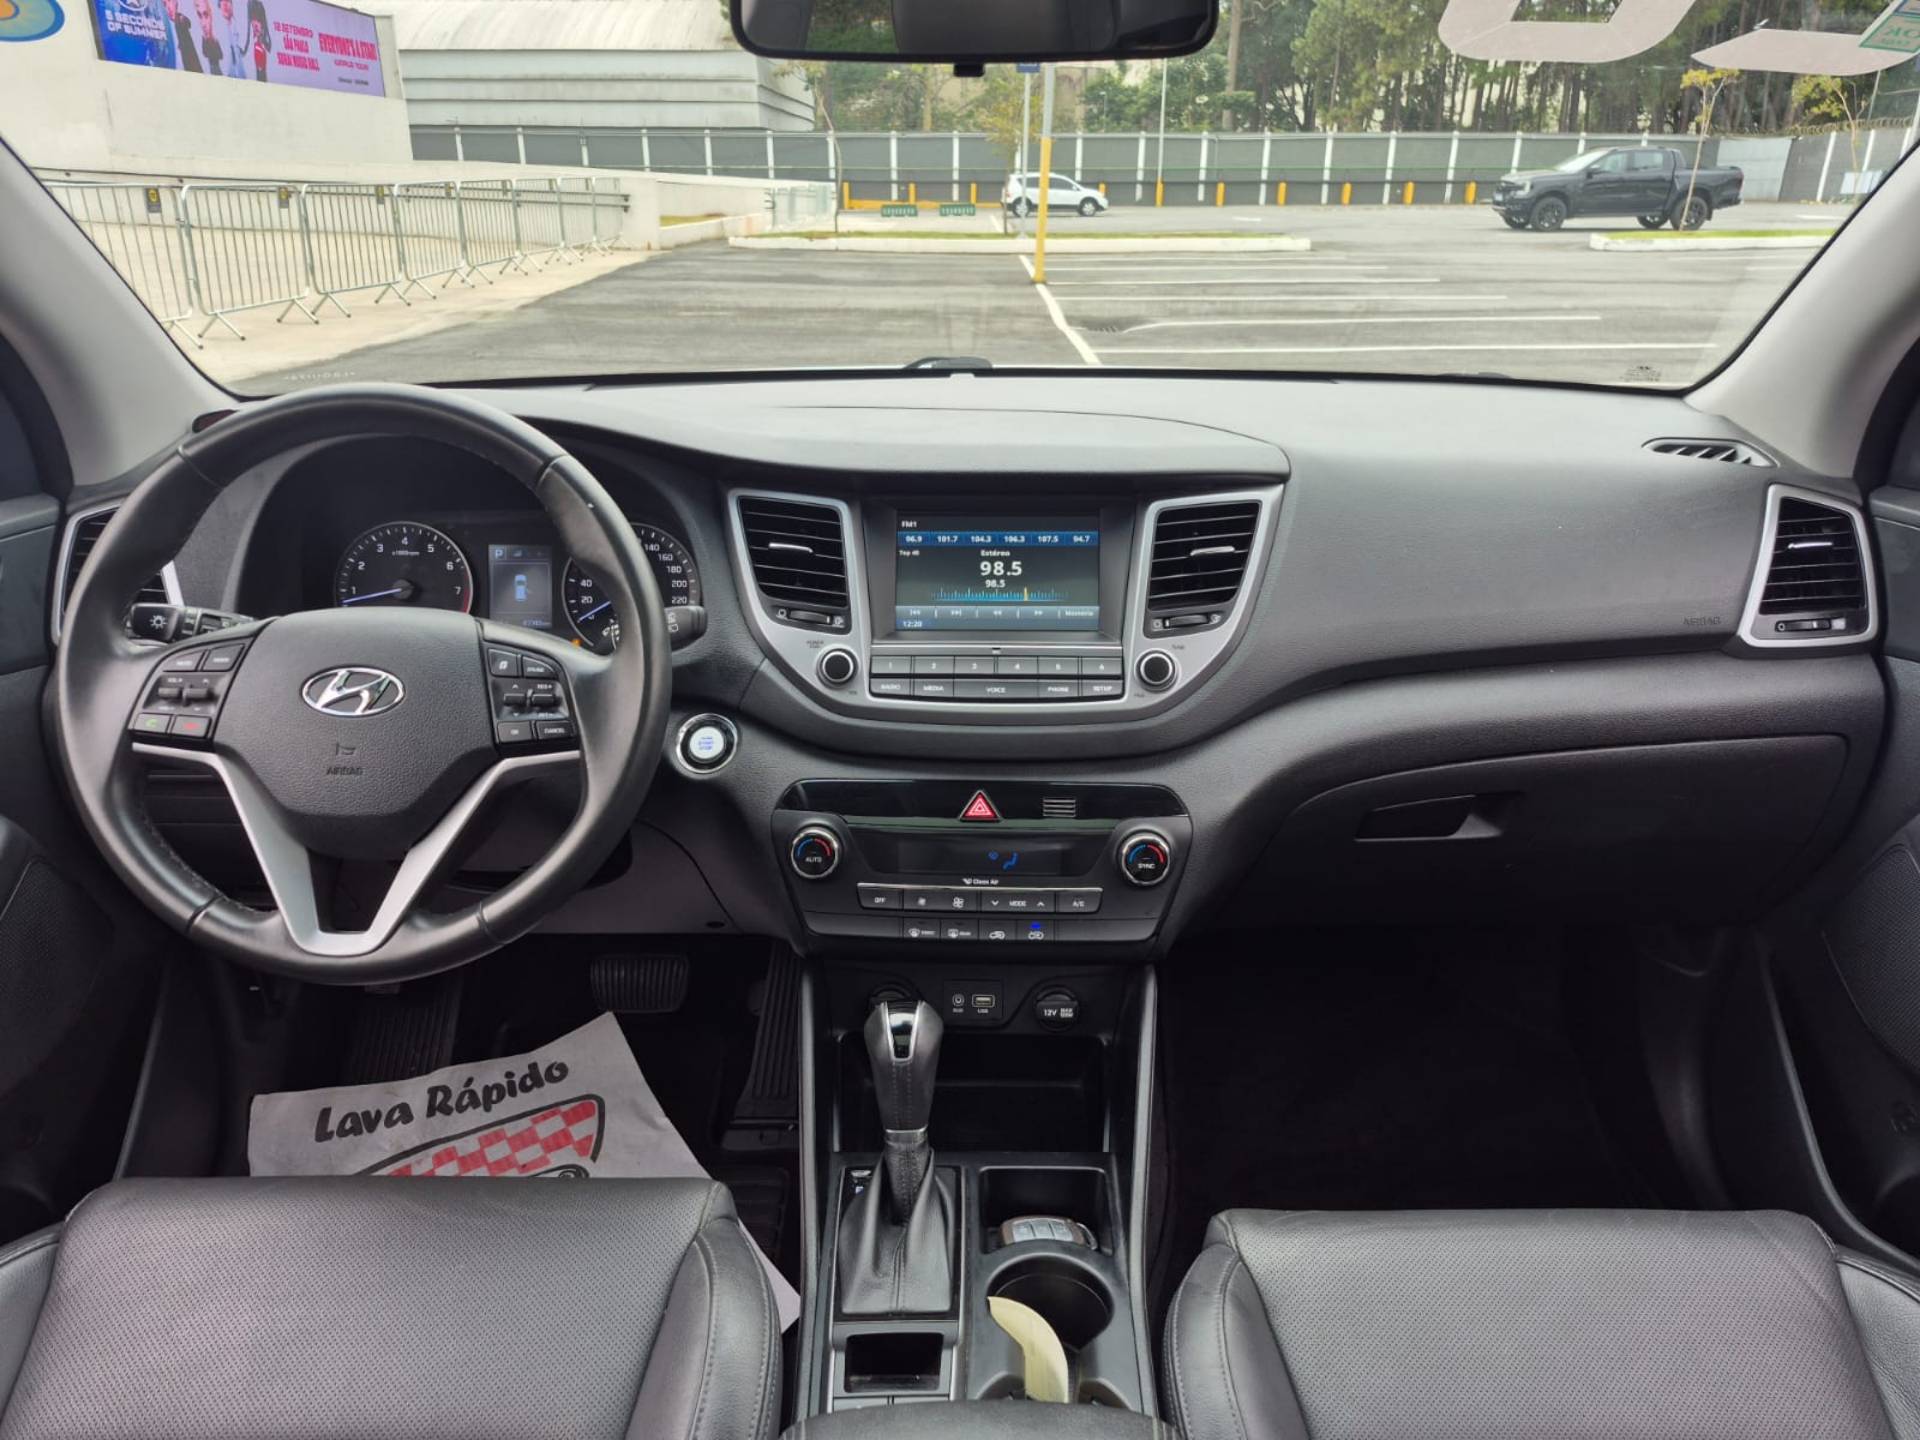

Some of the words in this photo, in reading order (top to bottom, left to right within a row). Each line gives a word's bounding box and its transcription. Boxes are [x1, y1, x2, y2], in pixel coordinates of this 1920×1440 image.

[106, 21, 122, 32] OF
[901, 520, 917, 528] FM1
[401, 537, 409, 546] 4
[937, 535, 958, 543] 101.7
[1038, 535, 1059, 543] 107.5
[1073, 535, 1090, 543] 94.7
[376, 544, 384, 553] 3
[427, 544, 435, 553] 5
[644, 543, 660, 551] 140
[495, 549, 504, 559] P
[658, 553, 673, 561] 160
[357, 562, 366, 571] 2
[446, 562, 454, 570] 6
[666, 565, 682, 573] 180
[980, 561, 1022, 576] 98.5
[580, 579, 593, 587] 40
[671, 580, 688, 588] 200
[985, 579, 1006, 588] 98.5
[351, 586, 357, 595] 1
[454, 586, 461, 595] 7
[580, 596, 593, 604] 20
[671, 596, 688, 604] 220
[931, 662, 937, 670] 2
[986, 686, 1006, 694] VOICE
[1044, 1009, 1057, 1017] 12V
[314, 1101, 414, 1143] Lava
[425, 1061, 569, 1118] Rápido
